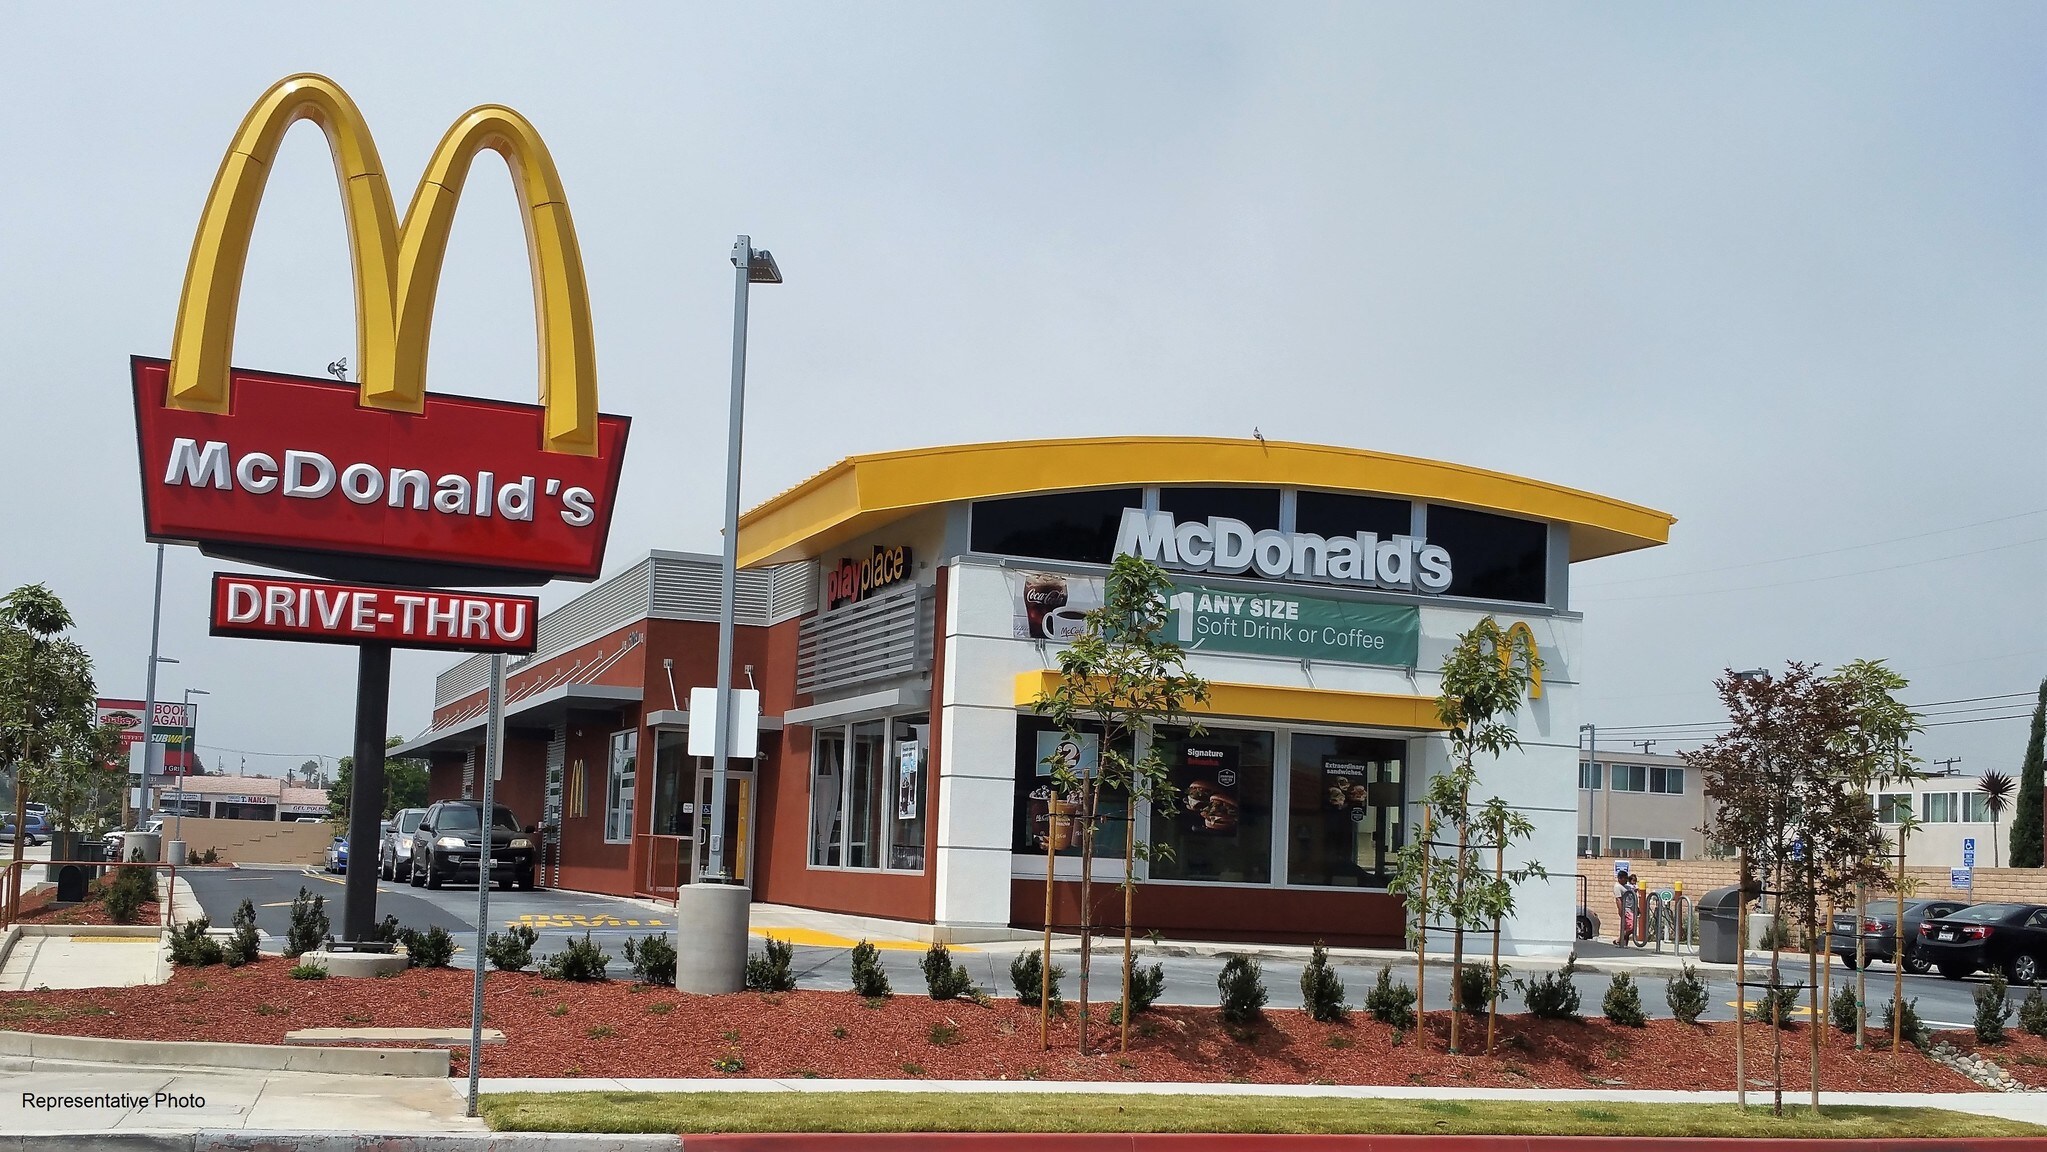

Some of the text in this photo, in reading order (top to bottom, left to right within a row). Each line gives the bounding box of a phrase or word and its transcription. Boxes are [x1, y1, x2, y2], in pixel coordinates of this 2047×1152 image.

[164, 437, 596, 527] McDonald's
[827, 545, 904, 611] playplace
[1113, 508, 1452, 591] McDonald's
[226, 583, 527, 642] DRIVE-THRU
[1197, 594, 1299, 621] ANY SIZE
[1197, 615, 1385, 650] Soft Drink or Coffee
[1187, 748, 1224, 758] Signature
